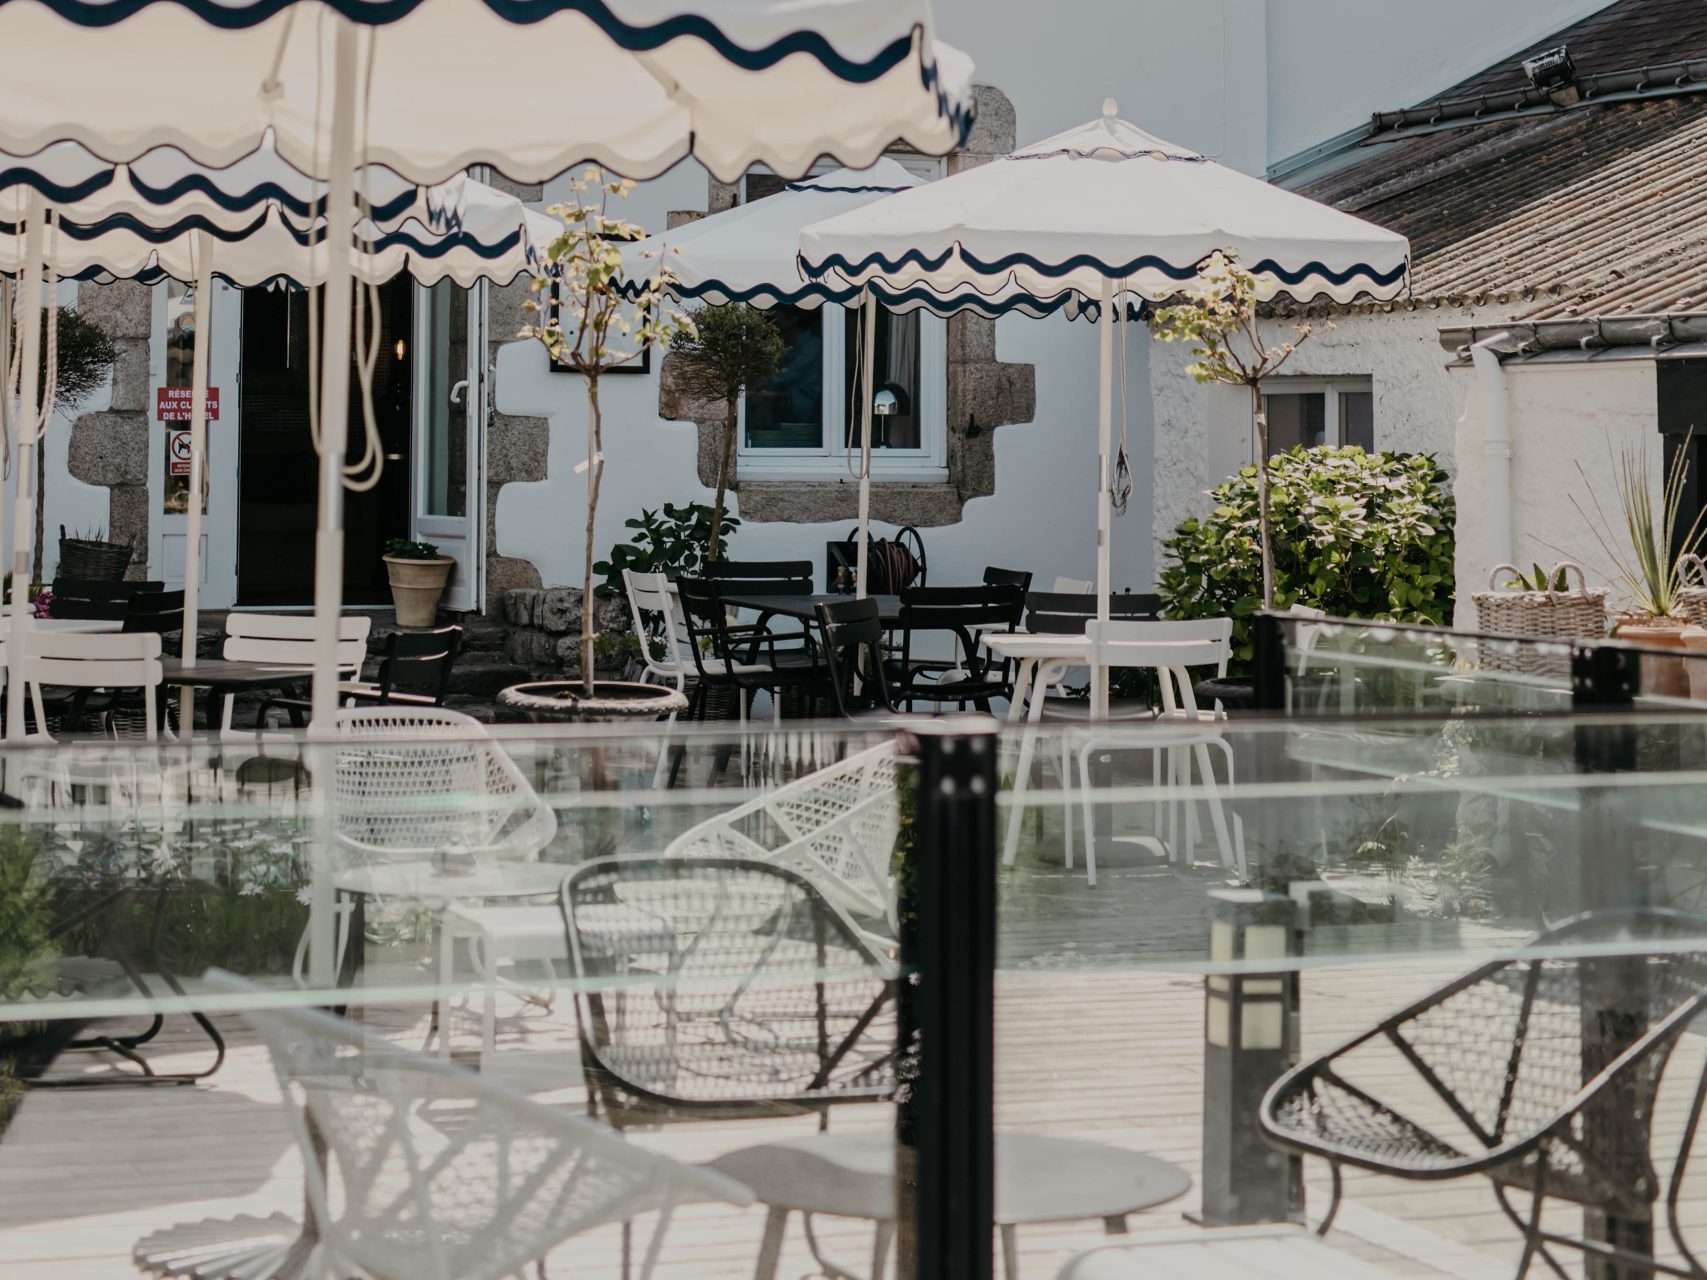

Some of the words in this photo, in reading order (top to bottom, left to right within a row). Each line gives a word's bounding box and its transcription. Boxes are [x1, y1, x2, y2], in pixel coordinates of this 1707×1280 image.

[168, 388, 209, 398] RÉSEE
[160, 401, 178, 409] AUX
[180, 401, 218, 409] CLTS
[163, 412, 175, 420] DE
[177, 412, 214, 420] L'HEL
